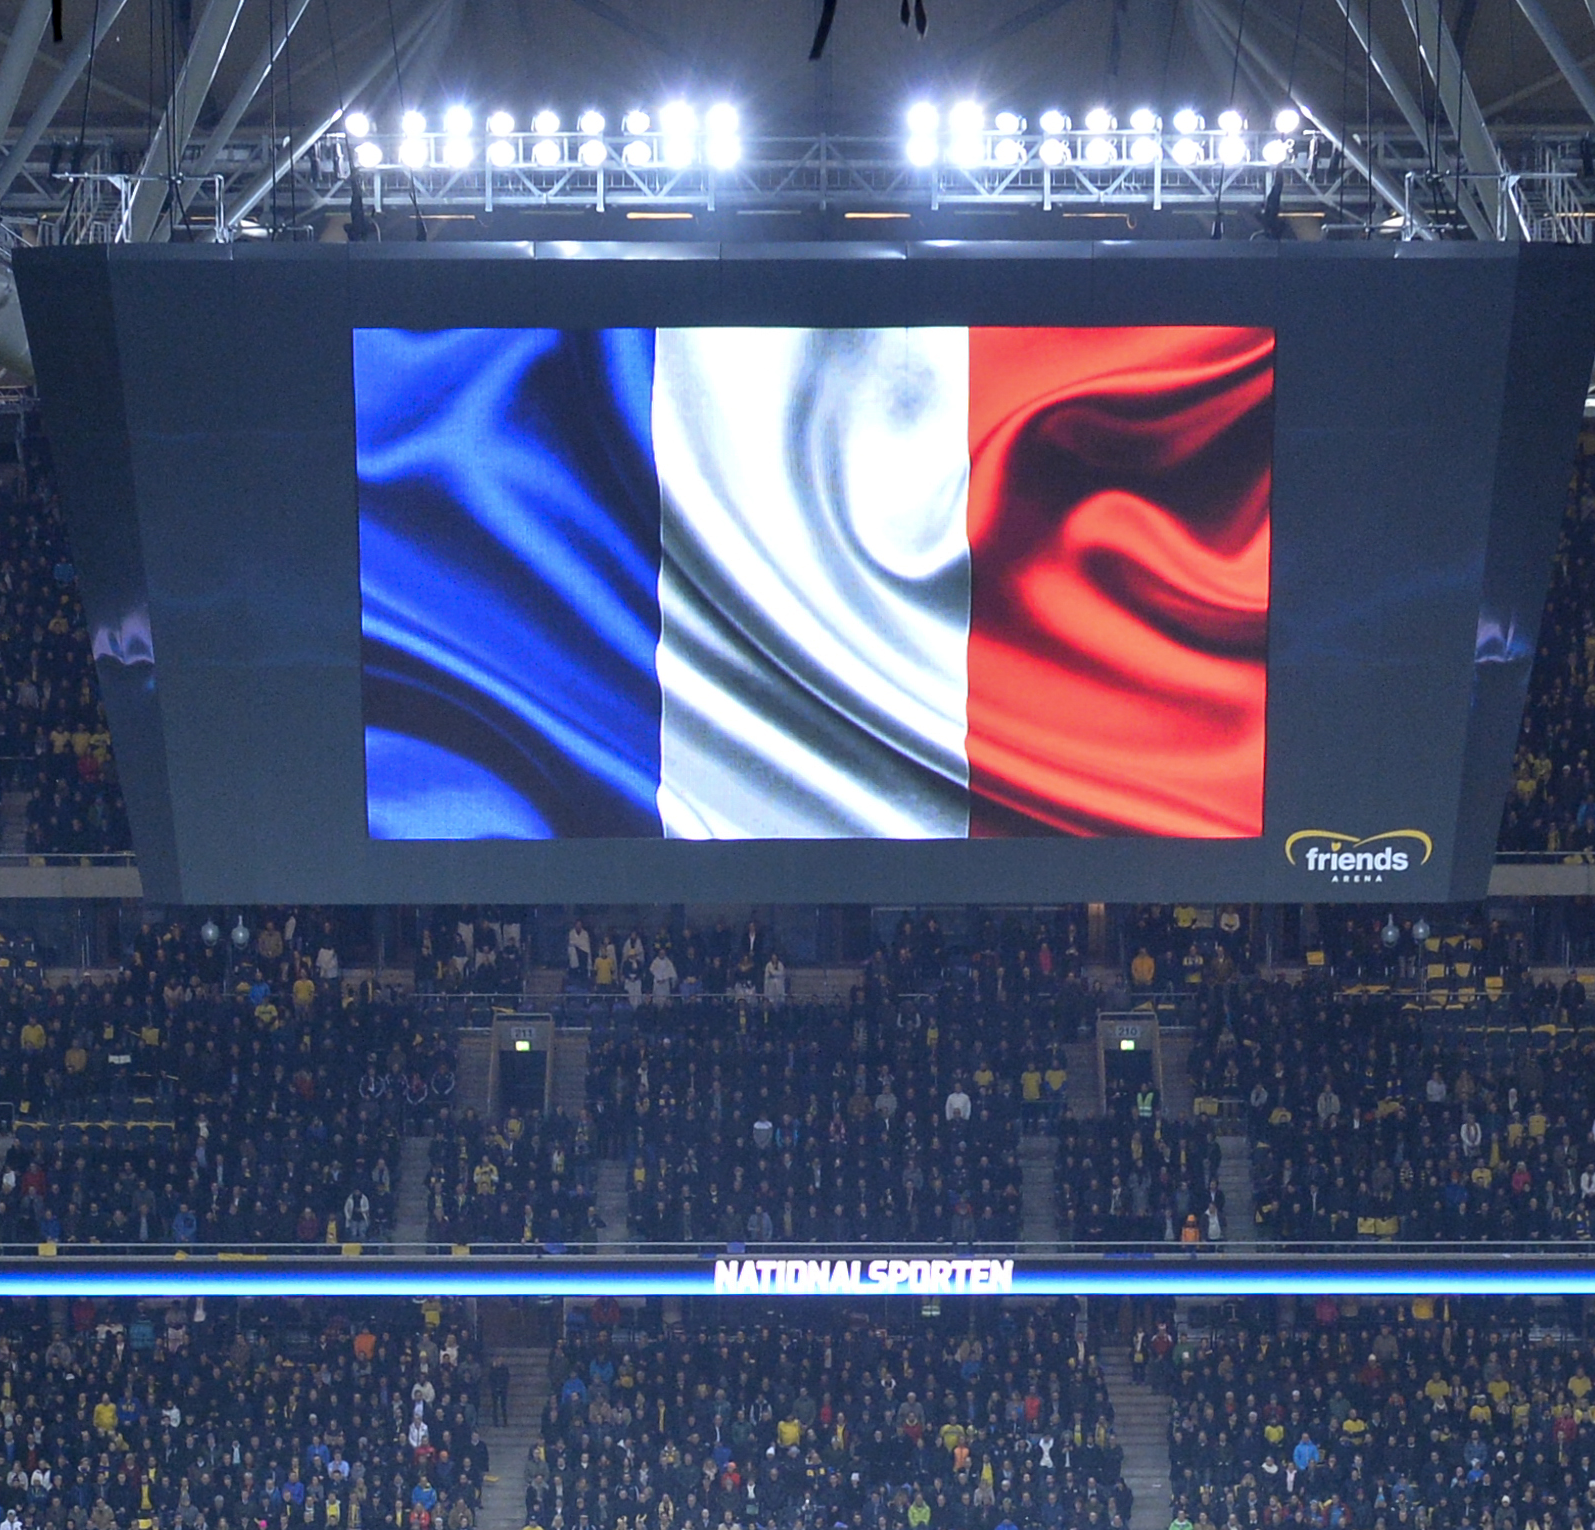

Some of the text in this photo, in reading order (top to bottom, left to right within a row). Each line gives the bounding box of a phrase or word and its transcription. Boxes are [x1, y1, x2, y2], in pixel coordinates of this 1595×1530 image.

[1306, 842, 1409, 871] friends
[1332, 875, 1383, 883] ARENA
[515, 1028, 533, 1038] 211
[1118, 1027, 1136, 1037] 210
[715, 1260, 1014, 1294] NATIONALSPORTEN
